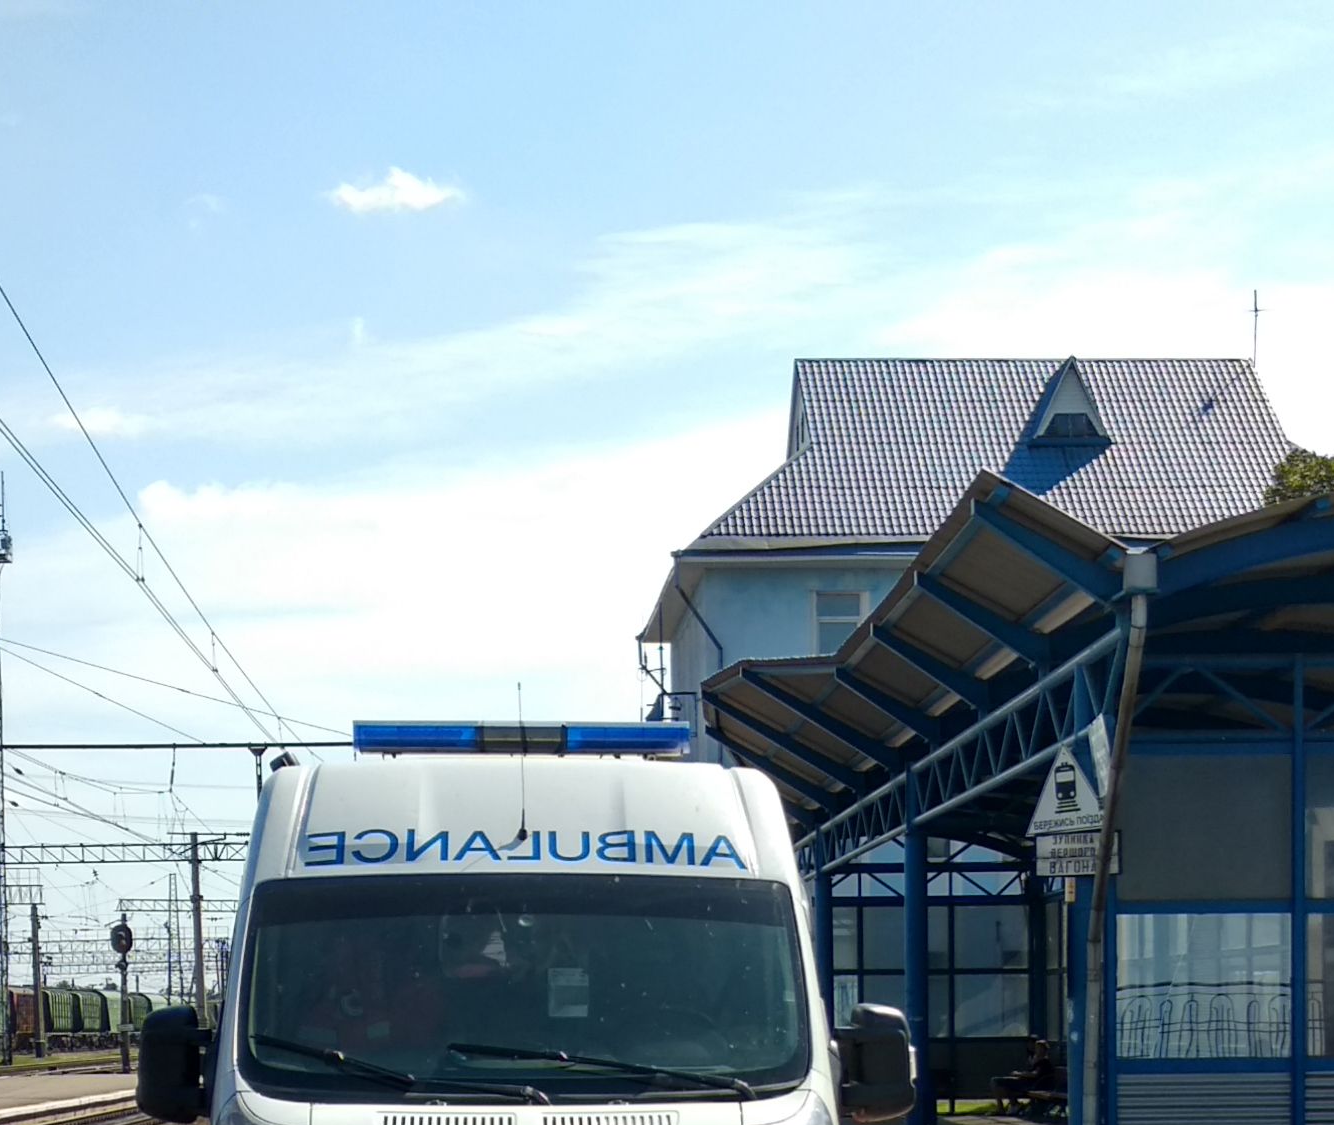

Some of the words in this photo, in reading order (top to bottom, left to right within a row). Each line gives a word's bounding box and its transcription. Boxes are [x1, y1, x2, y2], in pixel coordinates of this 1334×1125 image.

[1033, 817, 1075, 831] БЕРЕЖИСЬ
[1052, 834, 1094, 845] ЗУПИНКА
[1049, 859, 1097, 875] ВАГОНА
